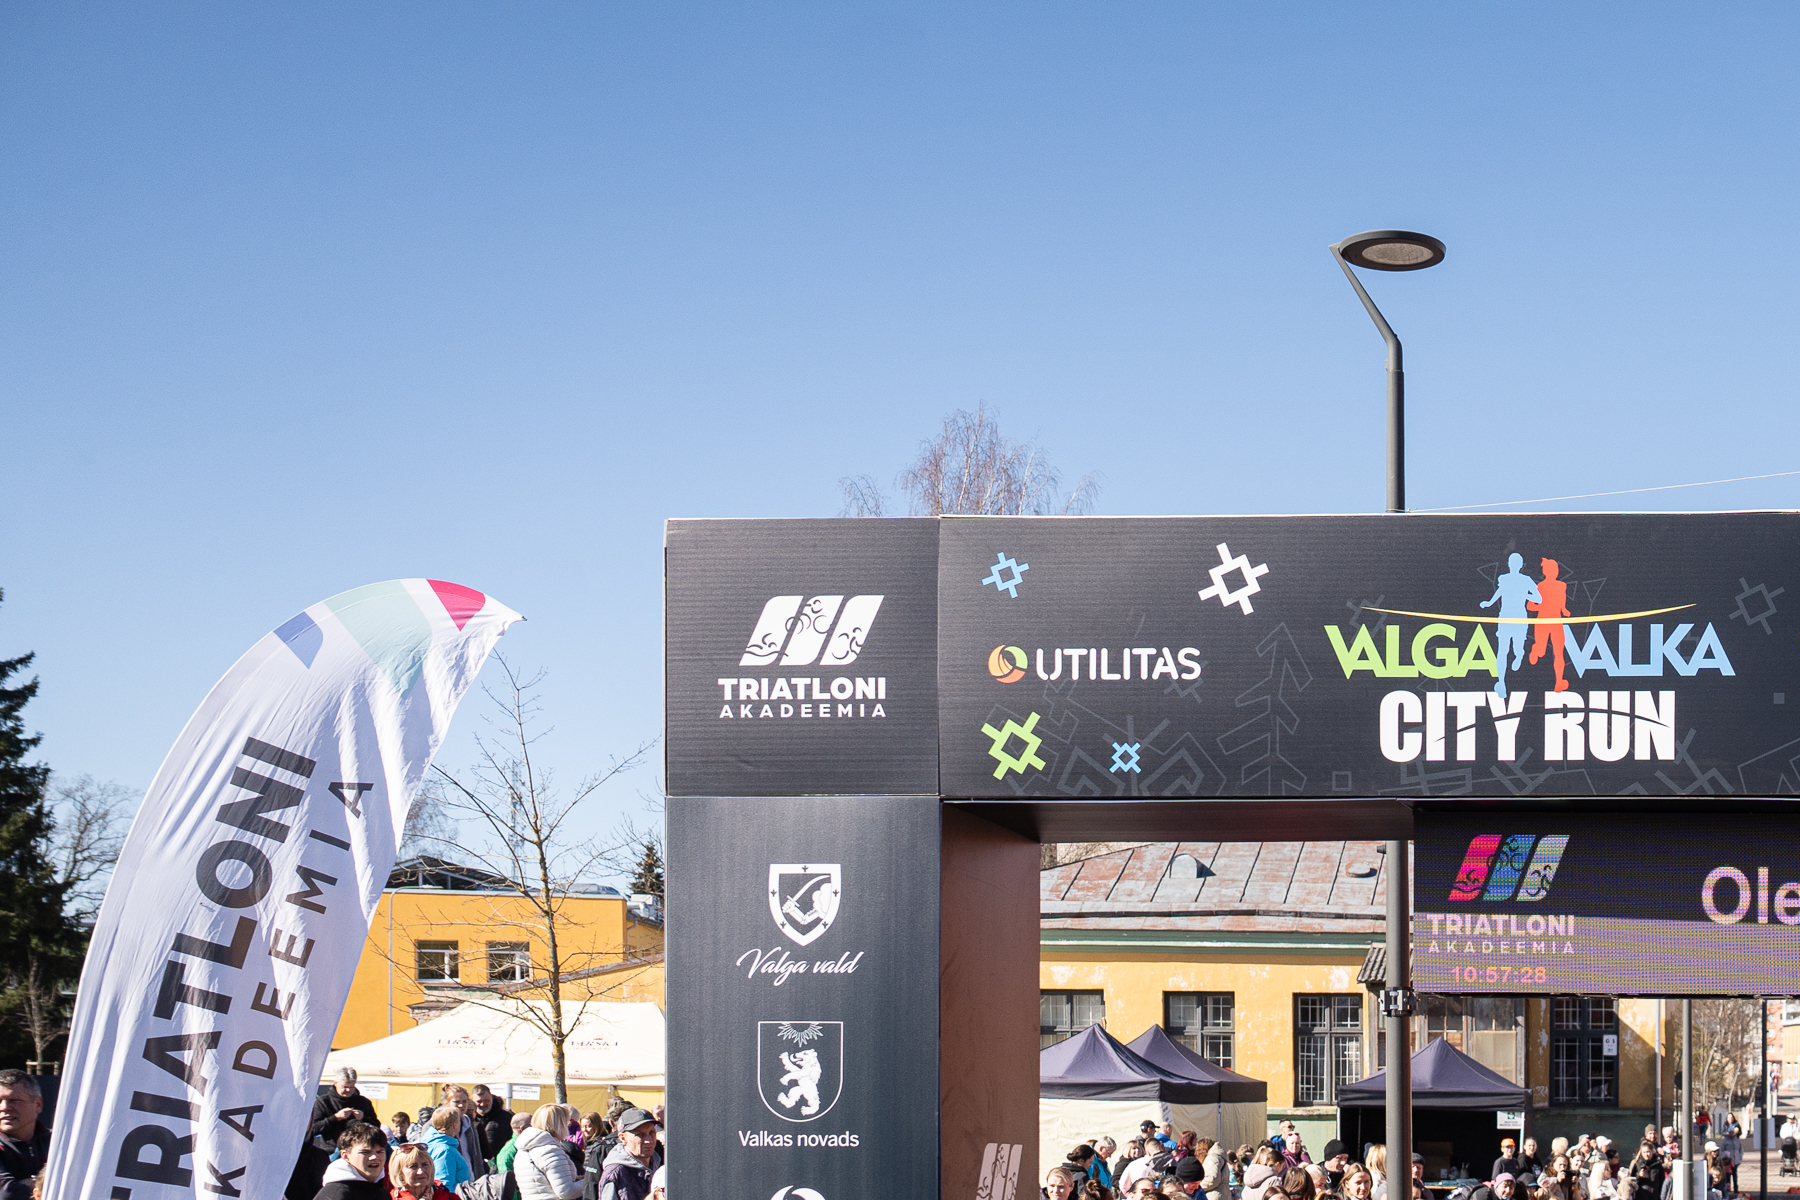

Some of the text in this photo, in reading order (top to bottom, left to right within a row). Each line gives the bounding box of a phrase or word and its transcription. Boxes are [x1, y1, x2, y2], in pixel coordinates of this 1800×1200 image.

[1324, 624, 1736, 678] VALGA VALKA
[1036, 647, 1201, 681] UTILITAS
[718, 677, 887, 700] TRIATLONI
[719, 703, 887, 719] AKADEEMIA
[1379, 690, 1675, 762] CITY RUN
[1427, 914, 1575, 936] TRIATLONI
[1428, 941, 1575, 954] AKADEEMIA
[735, 946, 864, 987] Valga vald
[1451, 966, 1547, 983] 10:57:28
[739, 1131, 860, 1147] Valkas novads
